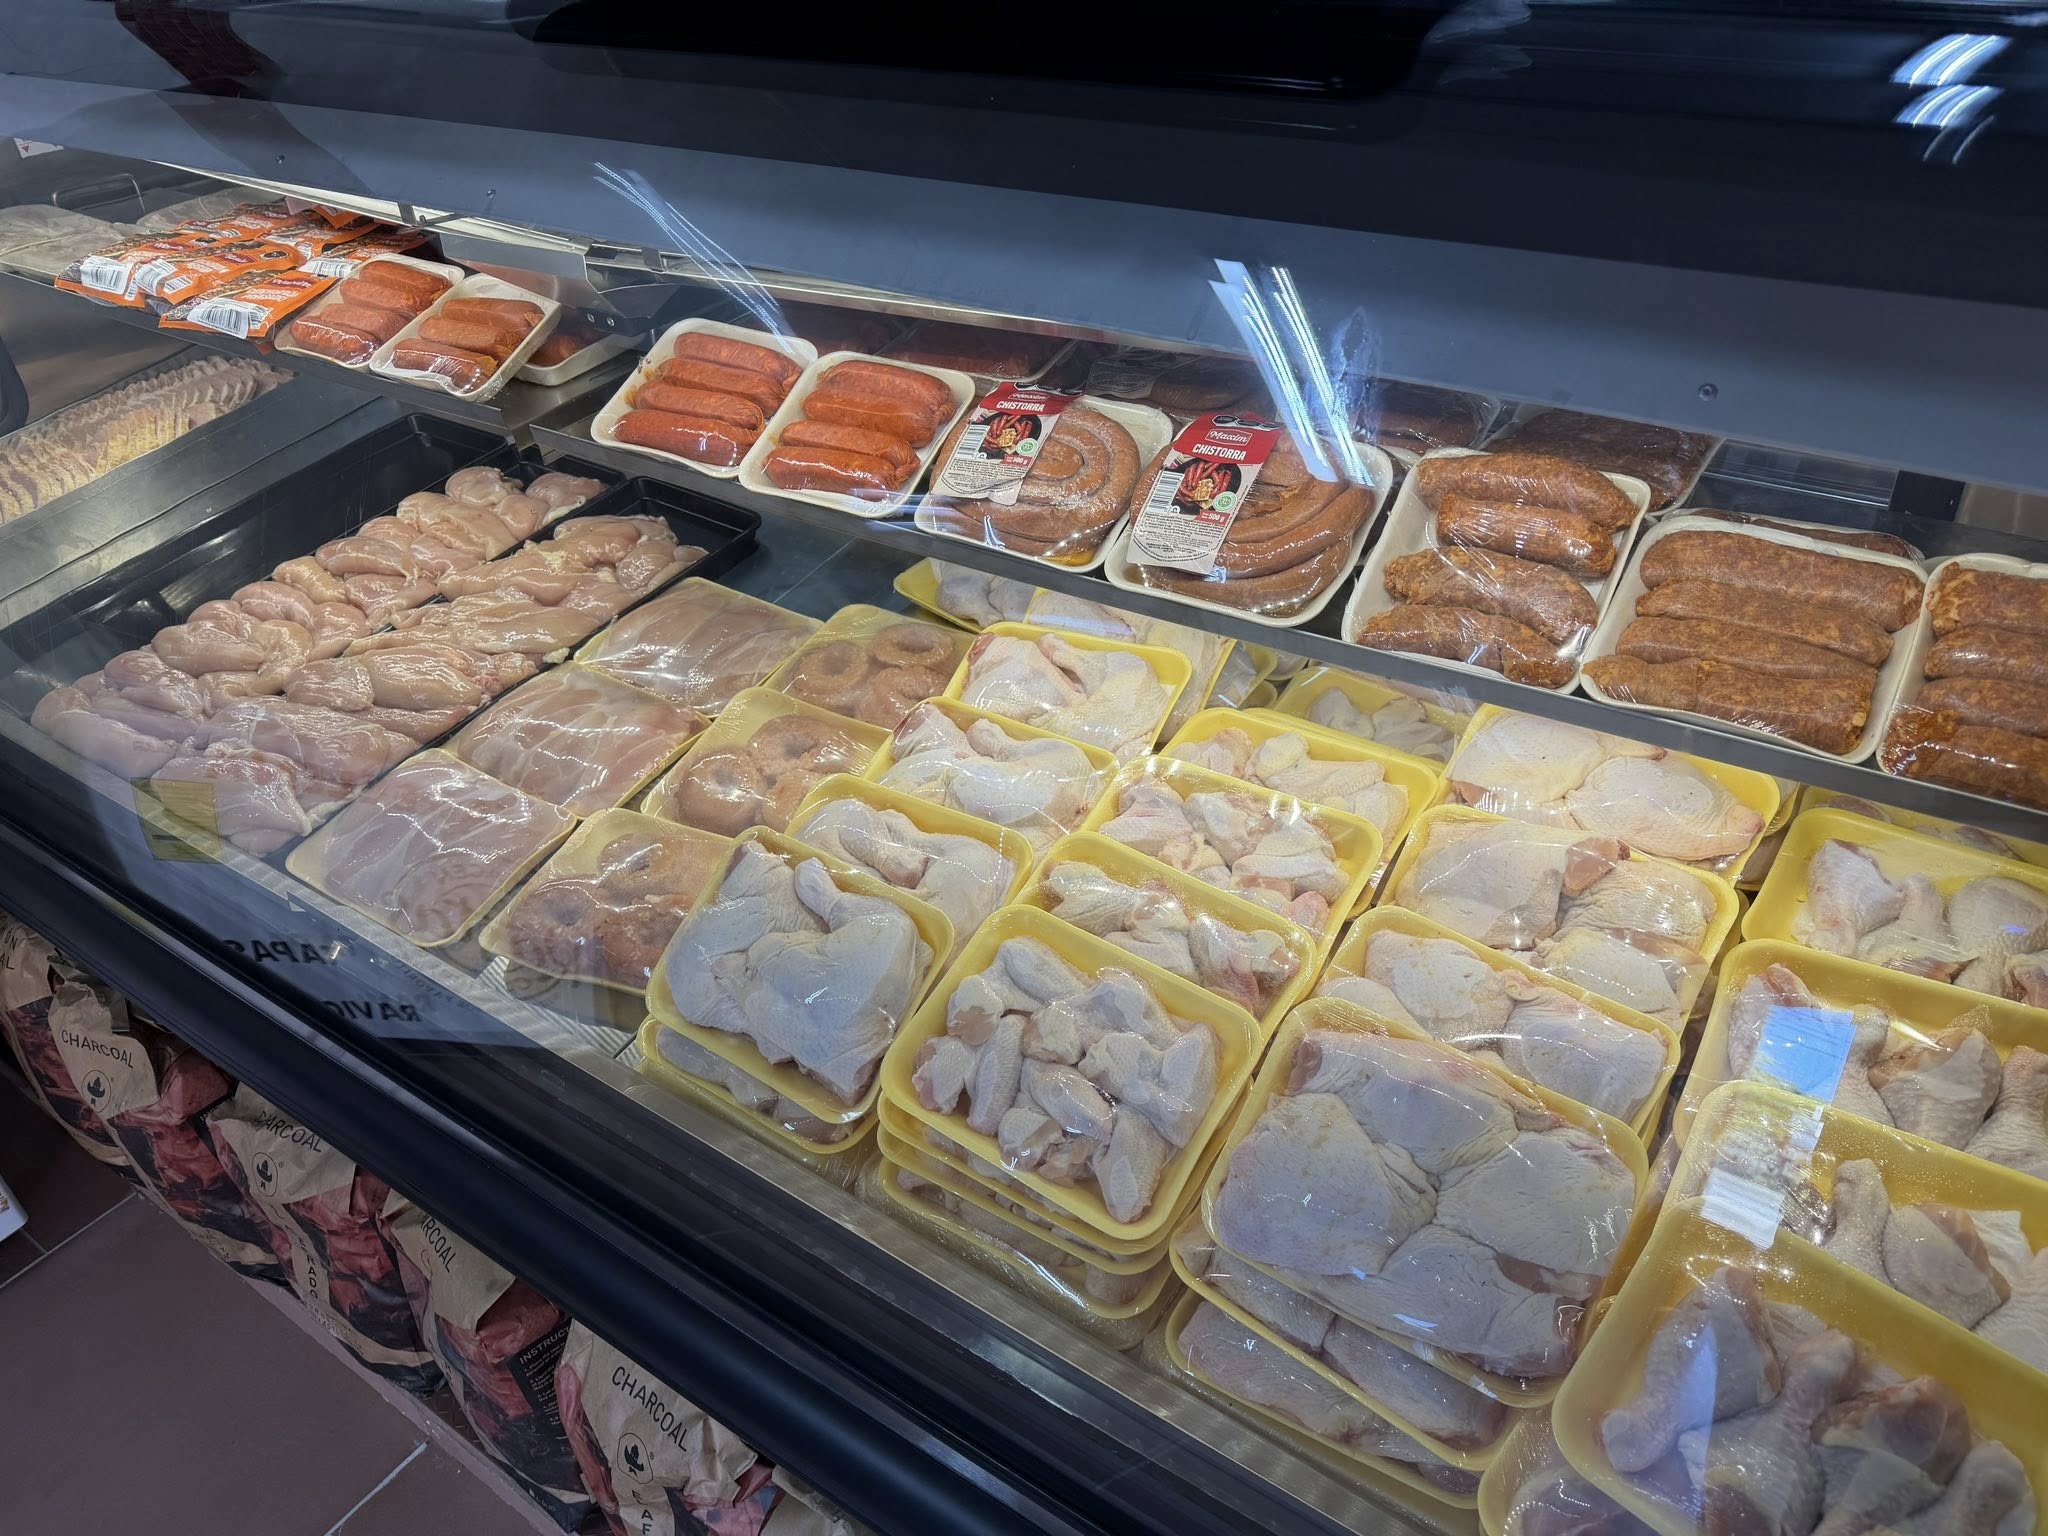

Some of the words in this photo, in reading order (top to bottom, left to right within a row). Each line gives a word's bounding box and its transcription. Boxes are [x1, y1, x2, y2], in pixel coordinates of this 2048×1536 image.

[996, 400, 1046, 412] CHISTORRA
[1209, 430, 1248, 443] Maxim
[1192, 443, 1247, 461] CHISTORRA
[1208, 511, 1220, 520] 500
[61, 1029, 134, 1069] CHARCOAL
[612, 1366, 687, 1452] CHARCOAL
